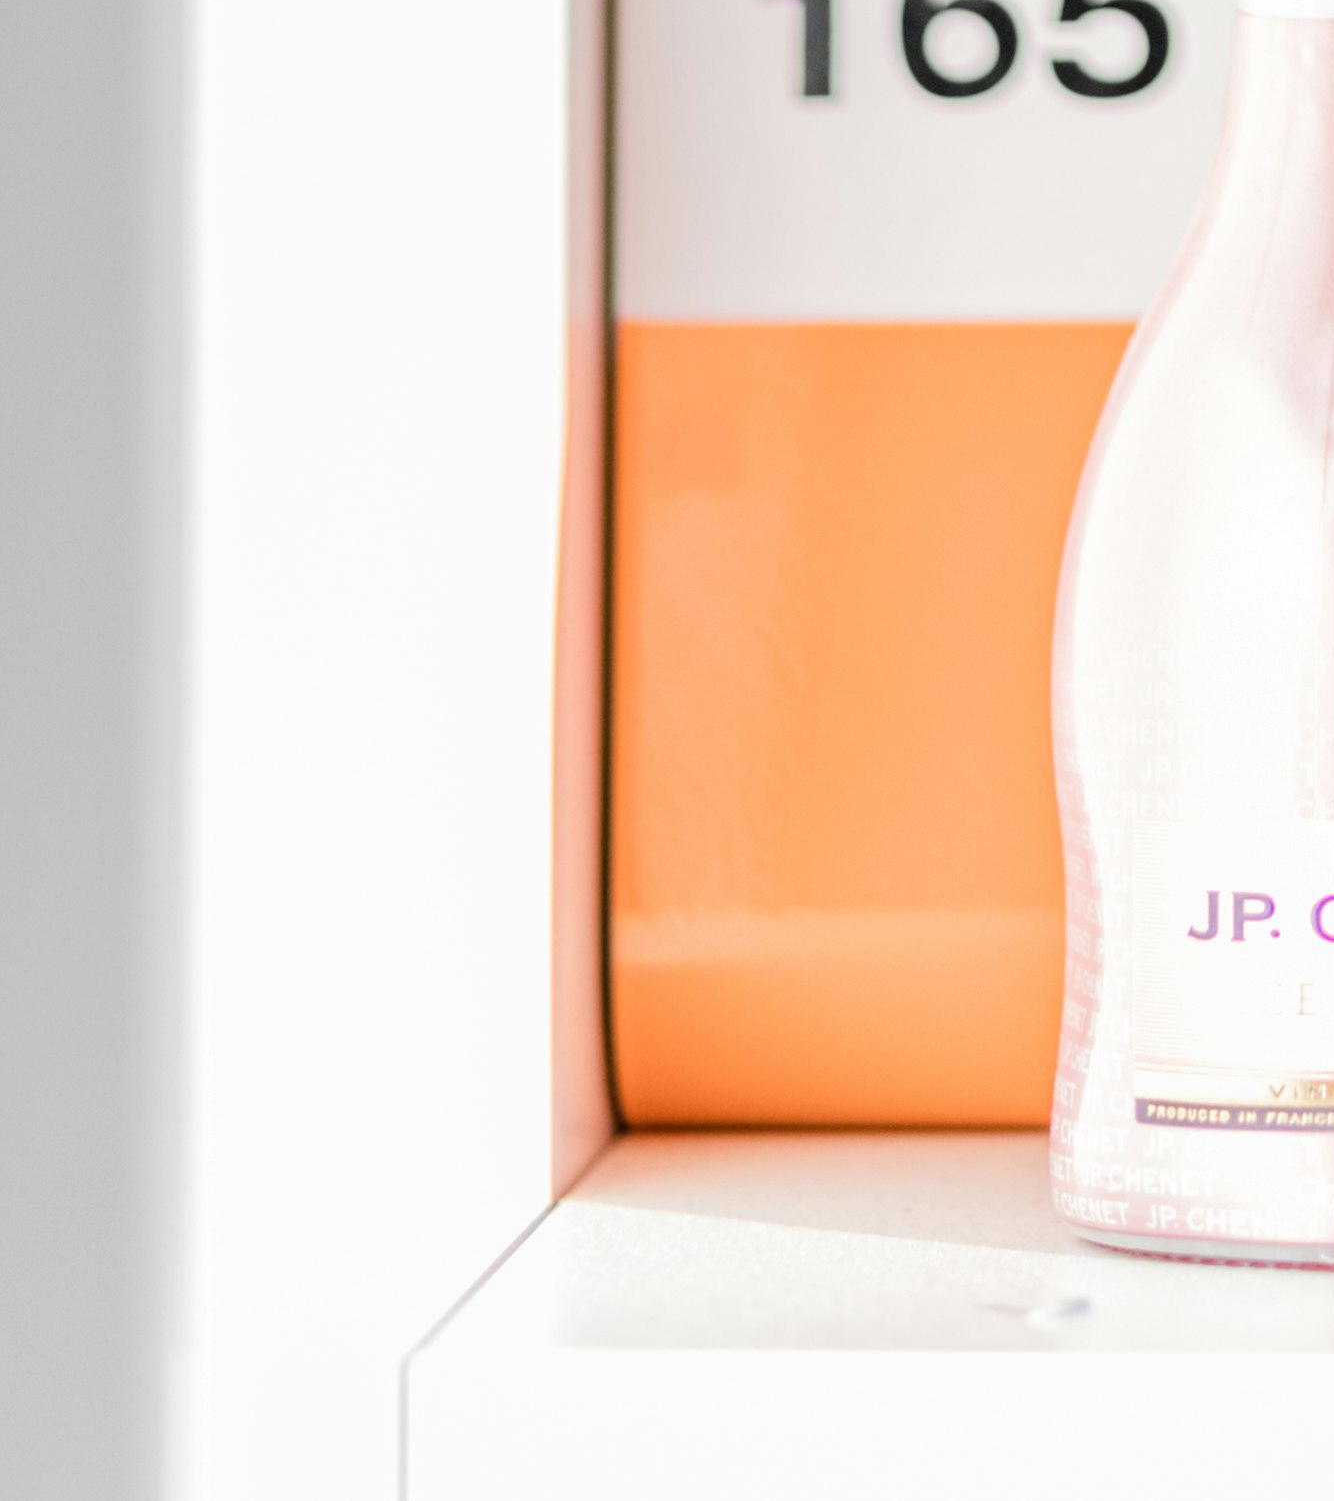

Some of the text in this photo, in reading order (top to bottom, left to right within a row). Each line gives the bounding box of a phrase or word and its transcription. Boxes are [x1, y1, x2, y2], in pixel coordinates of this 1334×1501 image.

[1186, 891, 1281, 943] JP.
[1268, 1083, 1326, 1099] VIN
[1147, 1103, 1230, 1124] PRODUCED
[1238, 1109, 1258, 1125] IN
